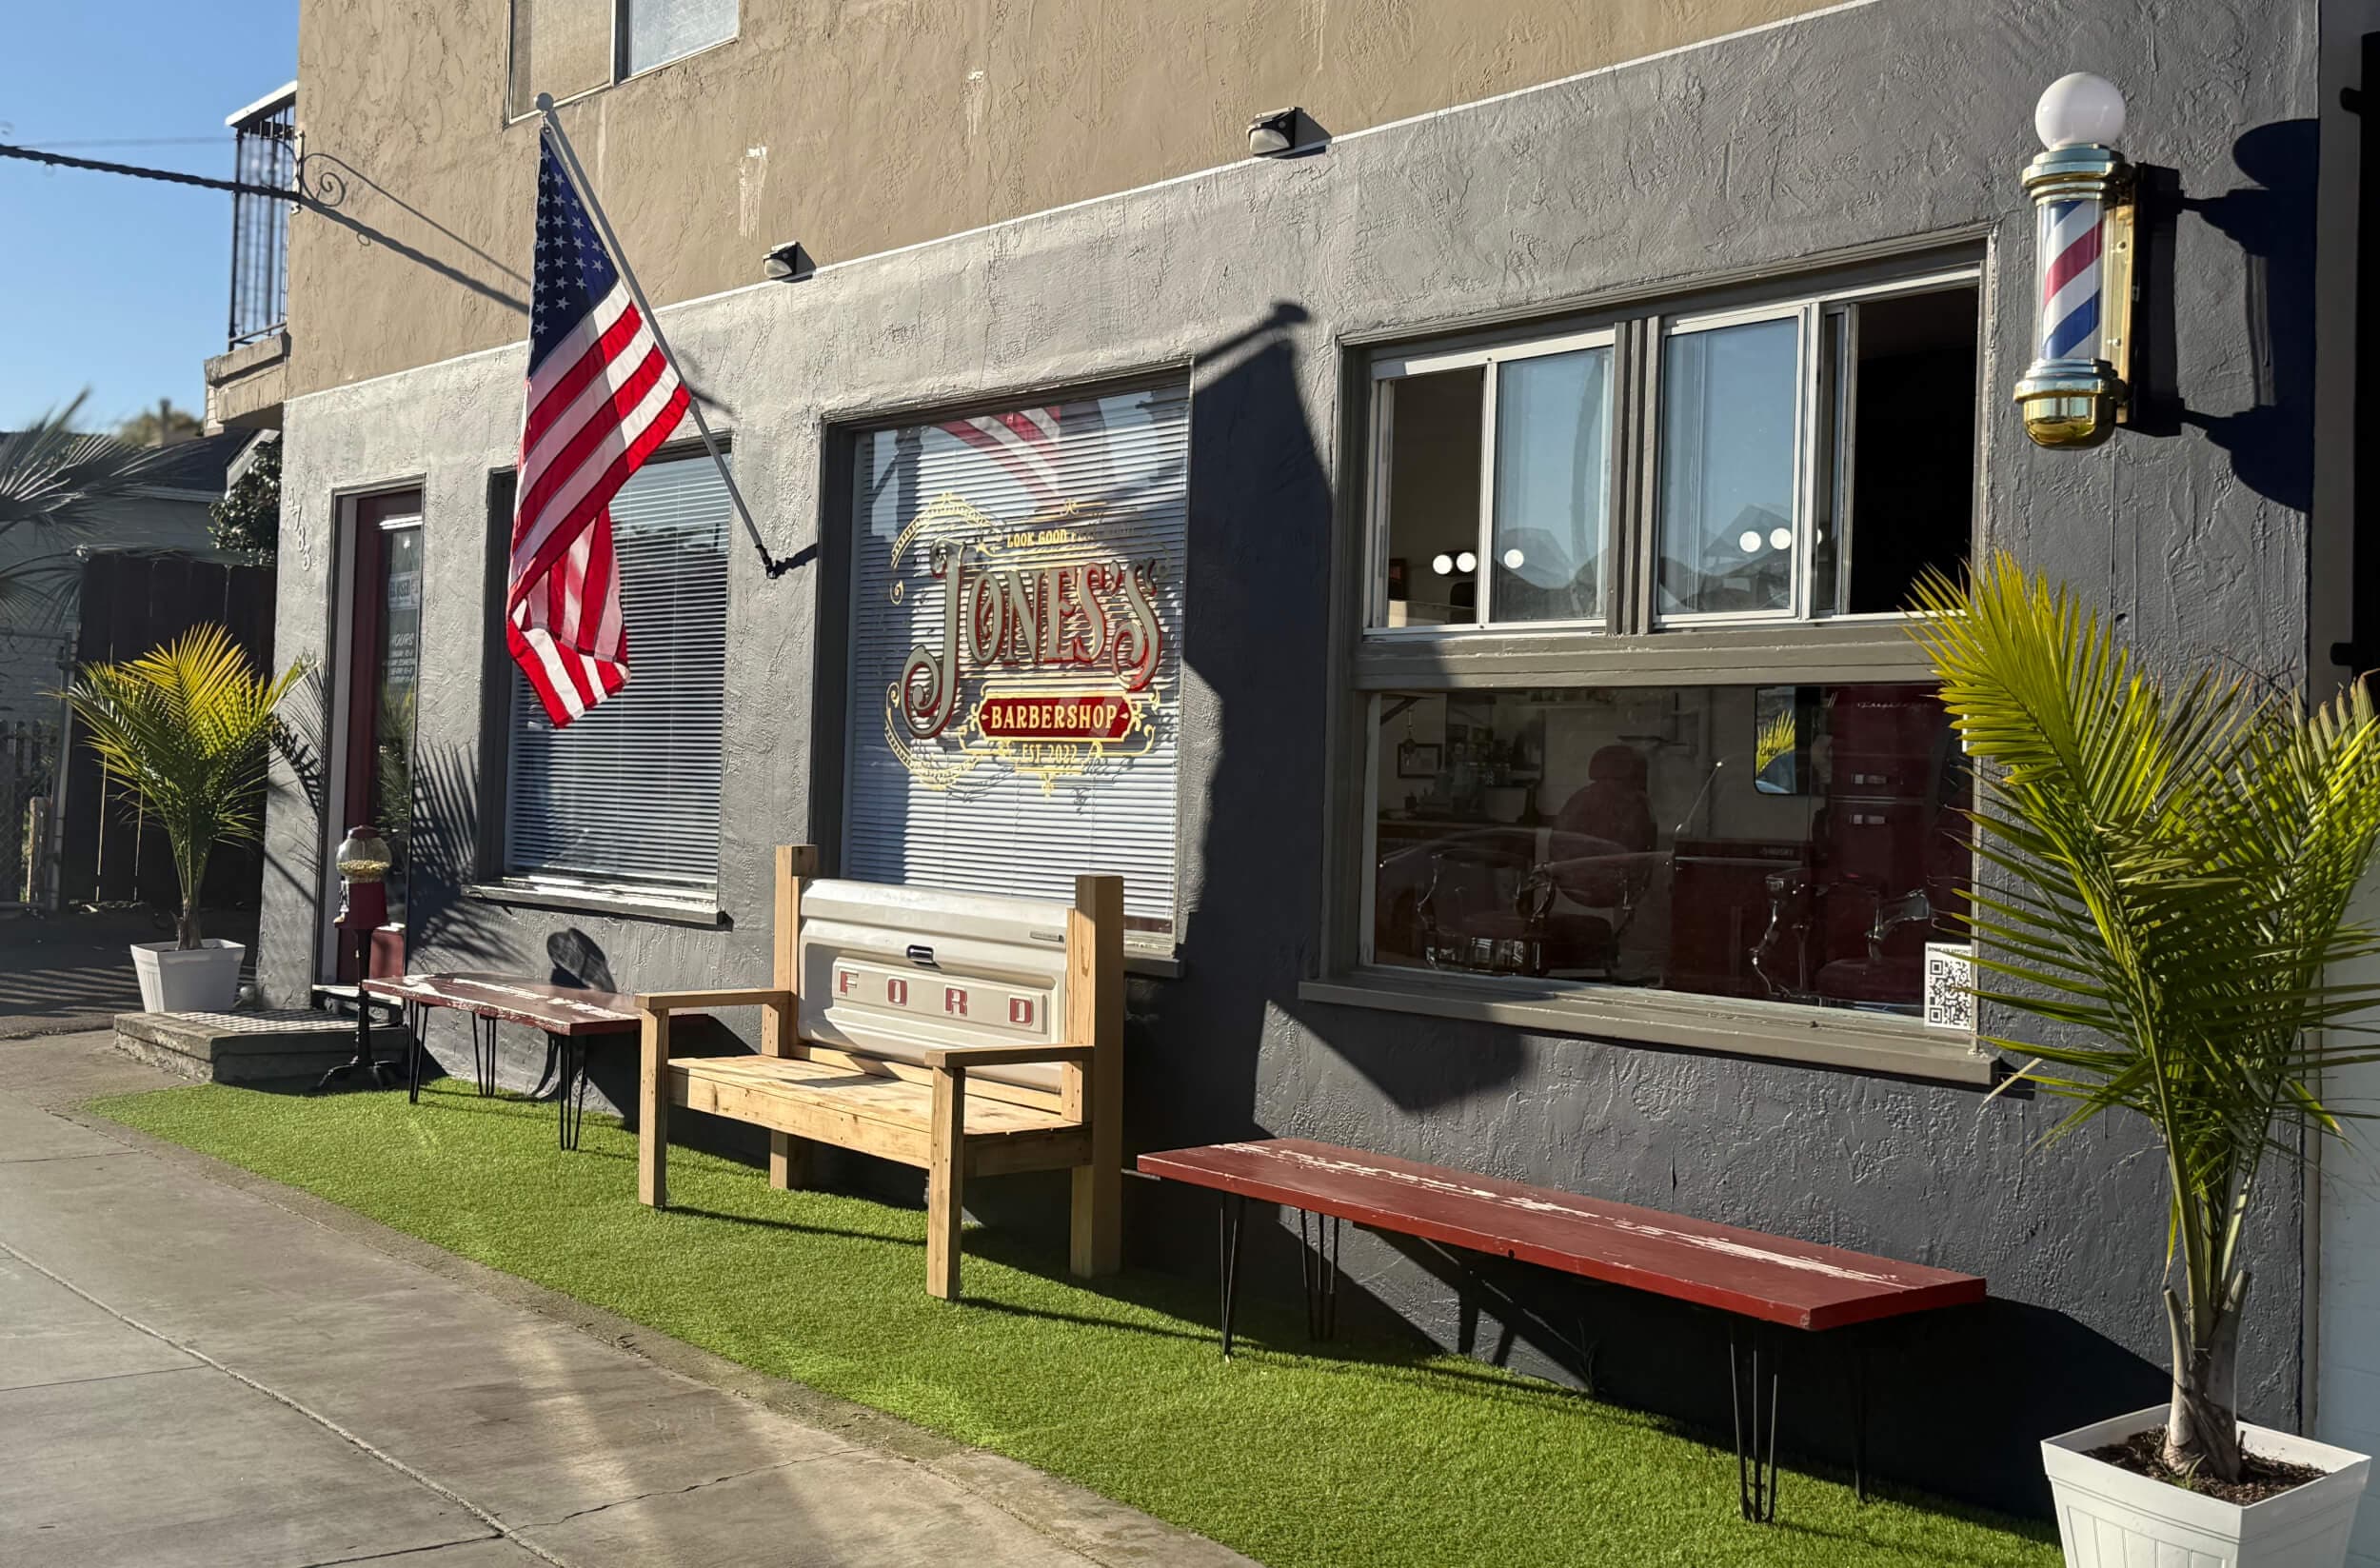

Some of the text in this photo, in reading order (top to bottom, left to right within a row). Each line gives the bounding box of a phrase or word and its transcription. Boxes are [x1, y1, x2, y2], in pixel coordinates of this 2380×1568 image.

[1006, 530, 1036, 548] LOOK
[1038, 528, 1068, 544] GOOD
[901, 537, 1163, 740] JONES'S
[991, 705, 1118, 729] BARBERSHOP
[1021, 744, 1078, 764] EST 2022
[839, 970, 1034, 1027] FORD
